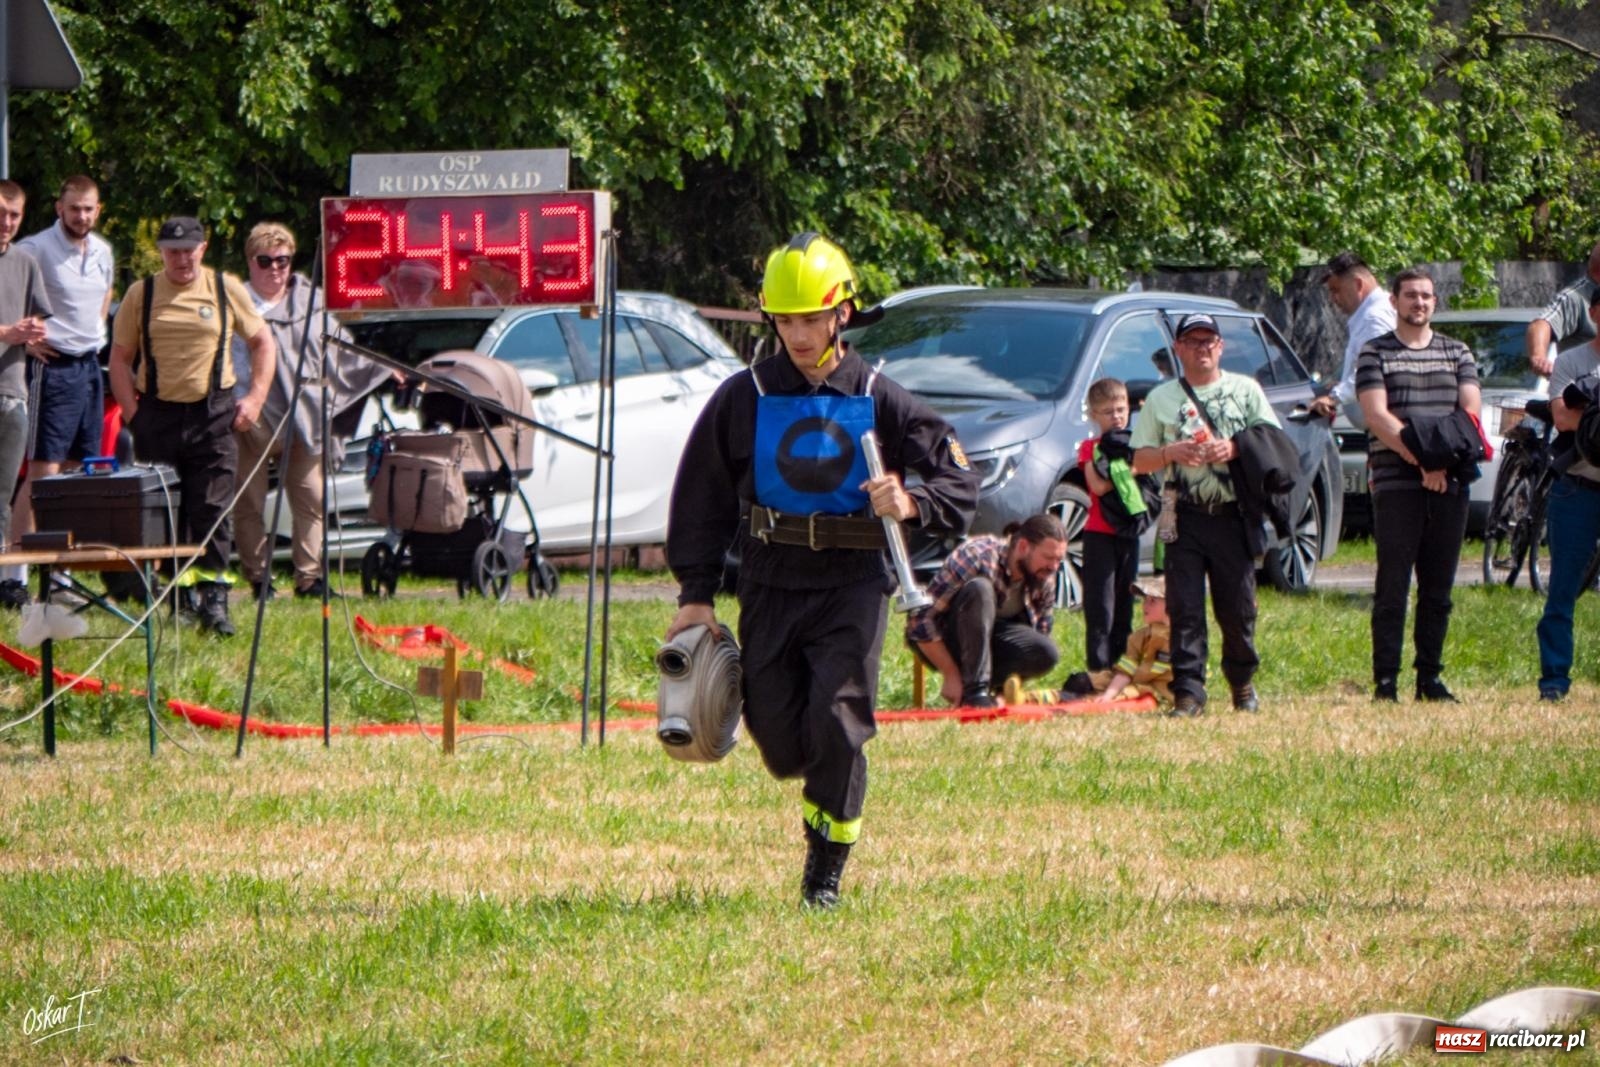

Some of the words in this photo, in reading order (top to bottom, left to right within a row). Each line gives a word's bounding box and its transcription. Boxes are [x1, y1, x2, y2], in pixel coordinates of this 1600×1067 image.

[440, 155, 482, 172] OSP
[378, 171, 542, 193] RUDYSZWAŁD
[337, 204, 590, 298] 24:43
